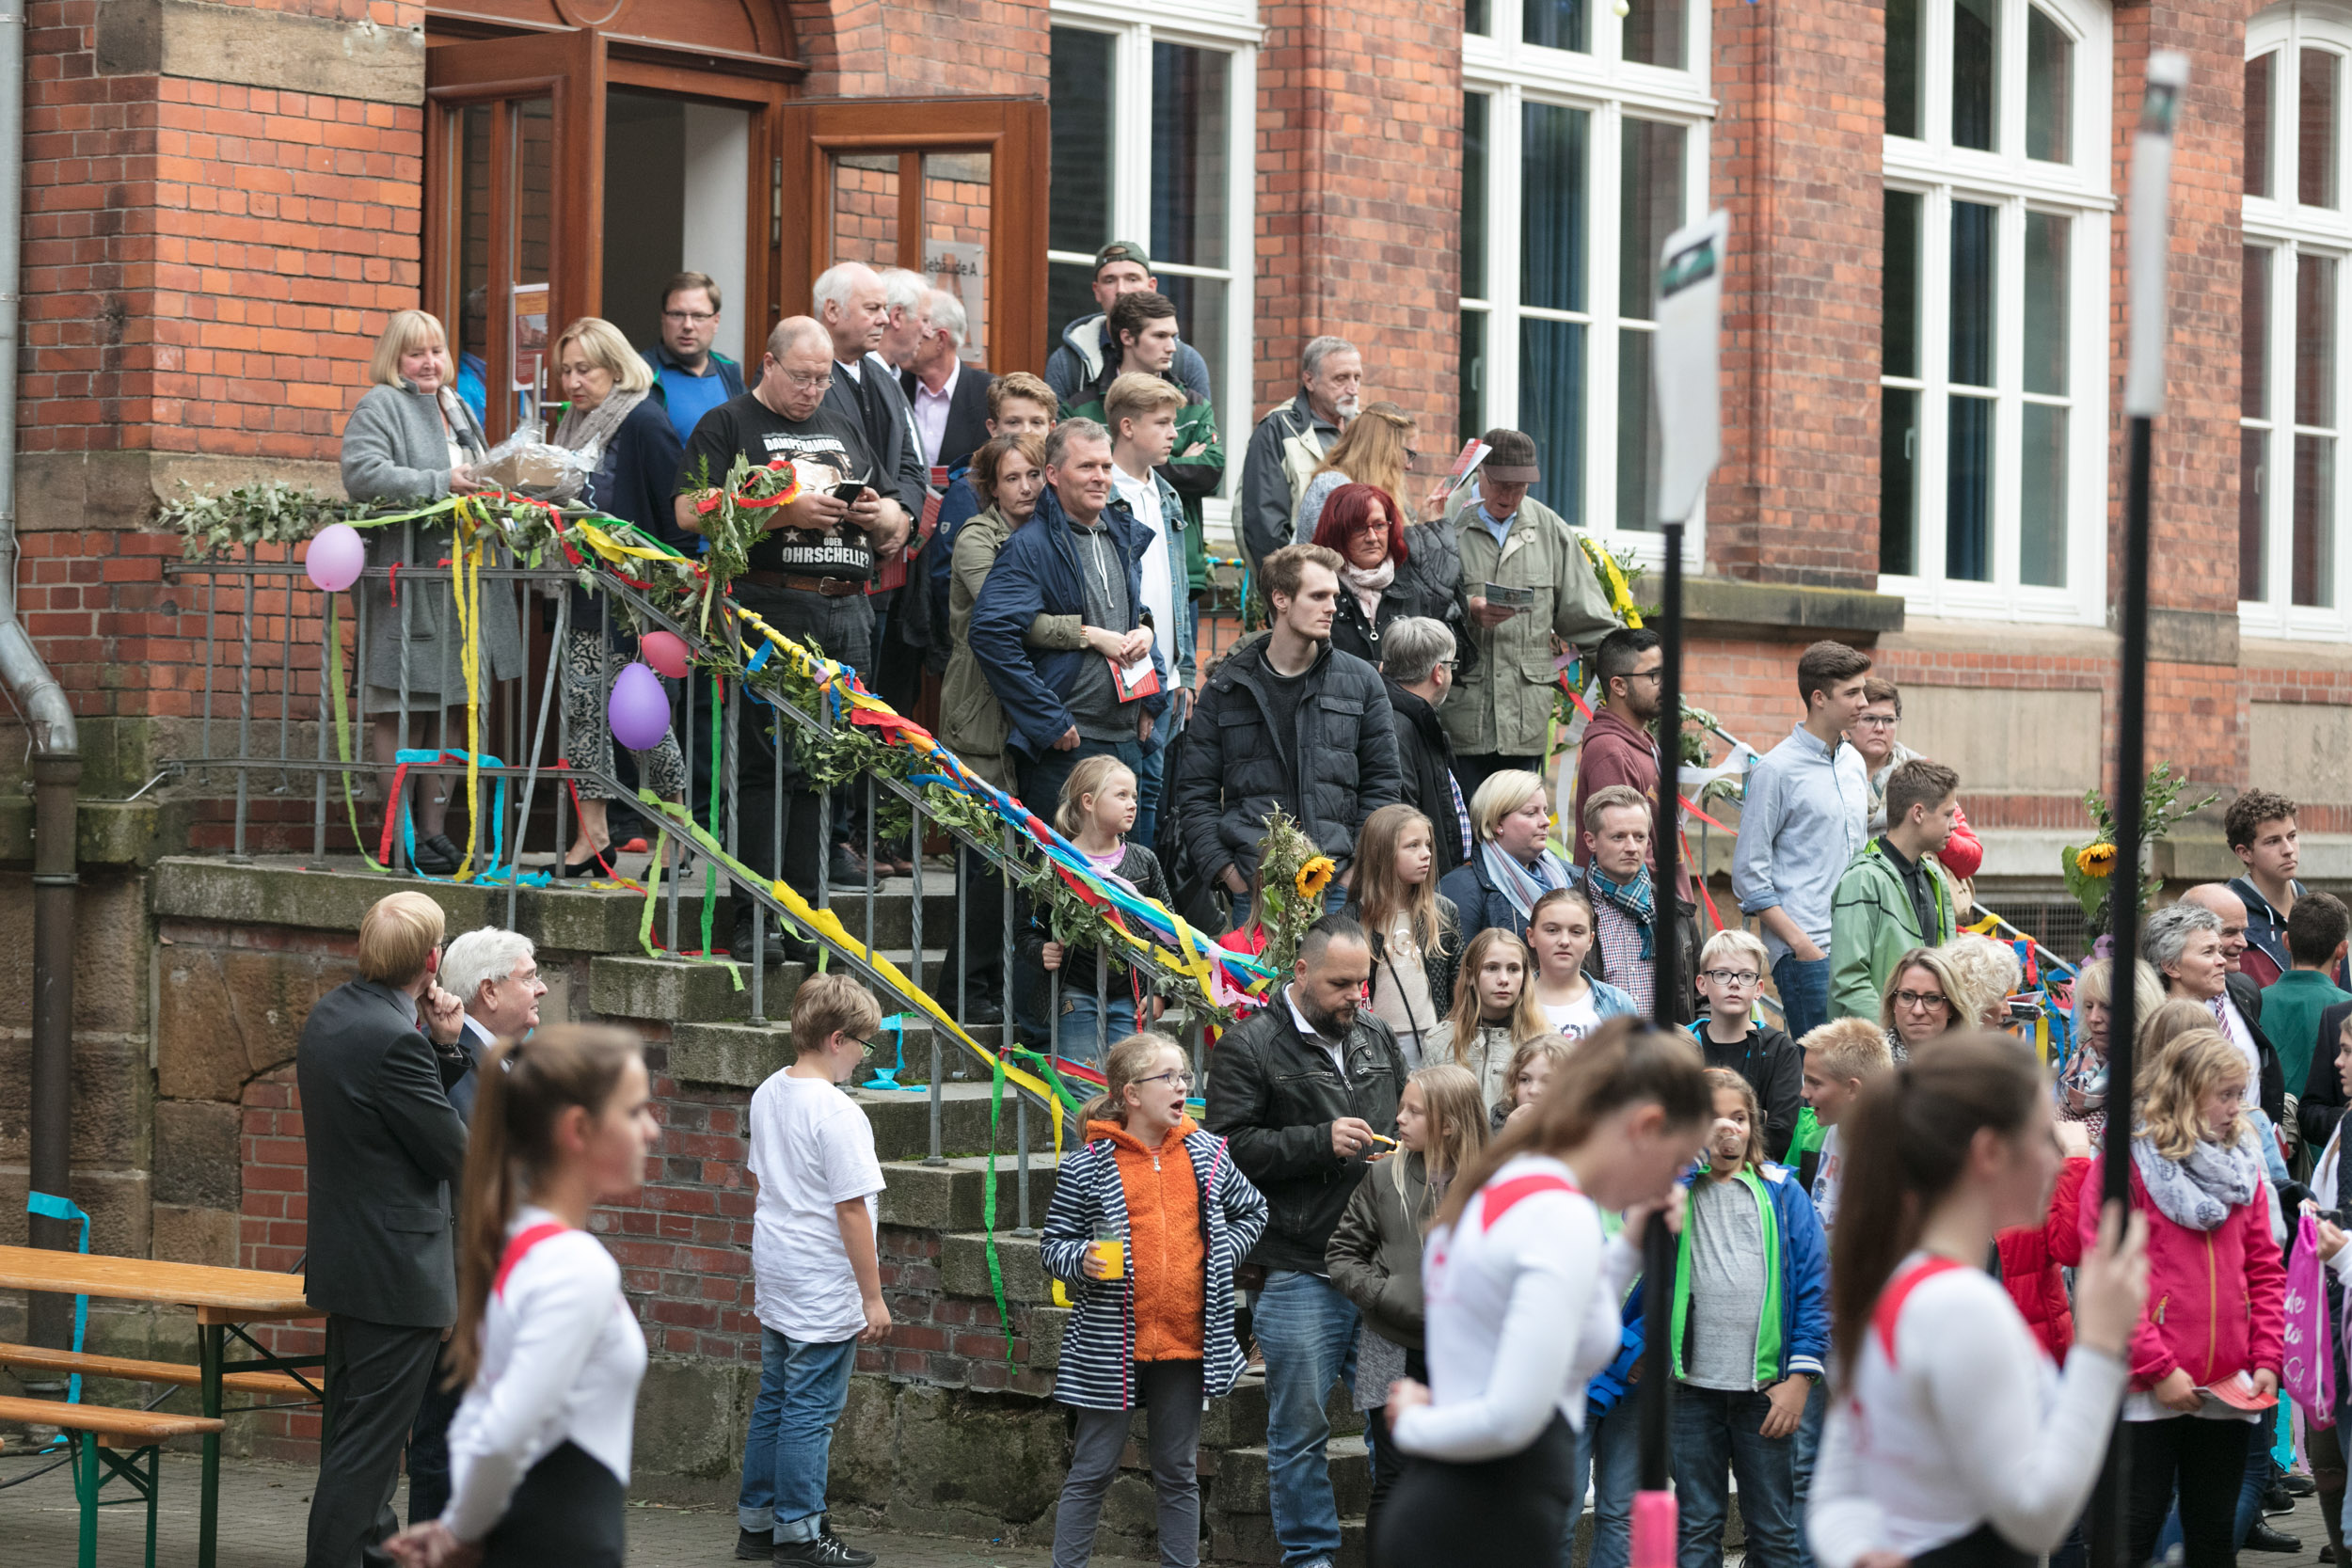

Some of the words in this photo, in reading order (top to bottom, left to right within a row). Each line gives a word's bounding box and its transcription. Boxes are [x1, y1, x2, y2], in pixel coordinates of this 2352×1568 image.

[969, 261, 978, 277] A
[763, 437, 846, 452] DAMPFHAMMER
[823, 537, 843, 546] ODER
[782, 546, 869, 568] OHRSCHELLE?
